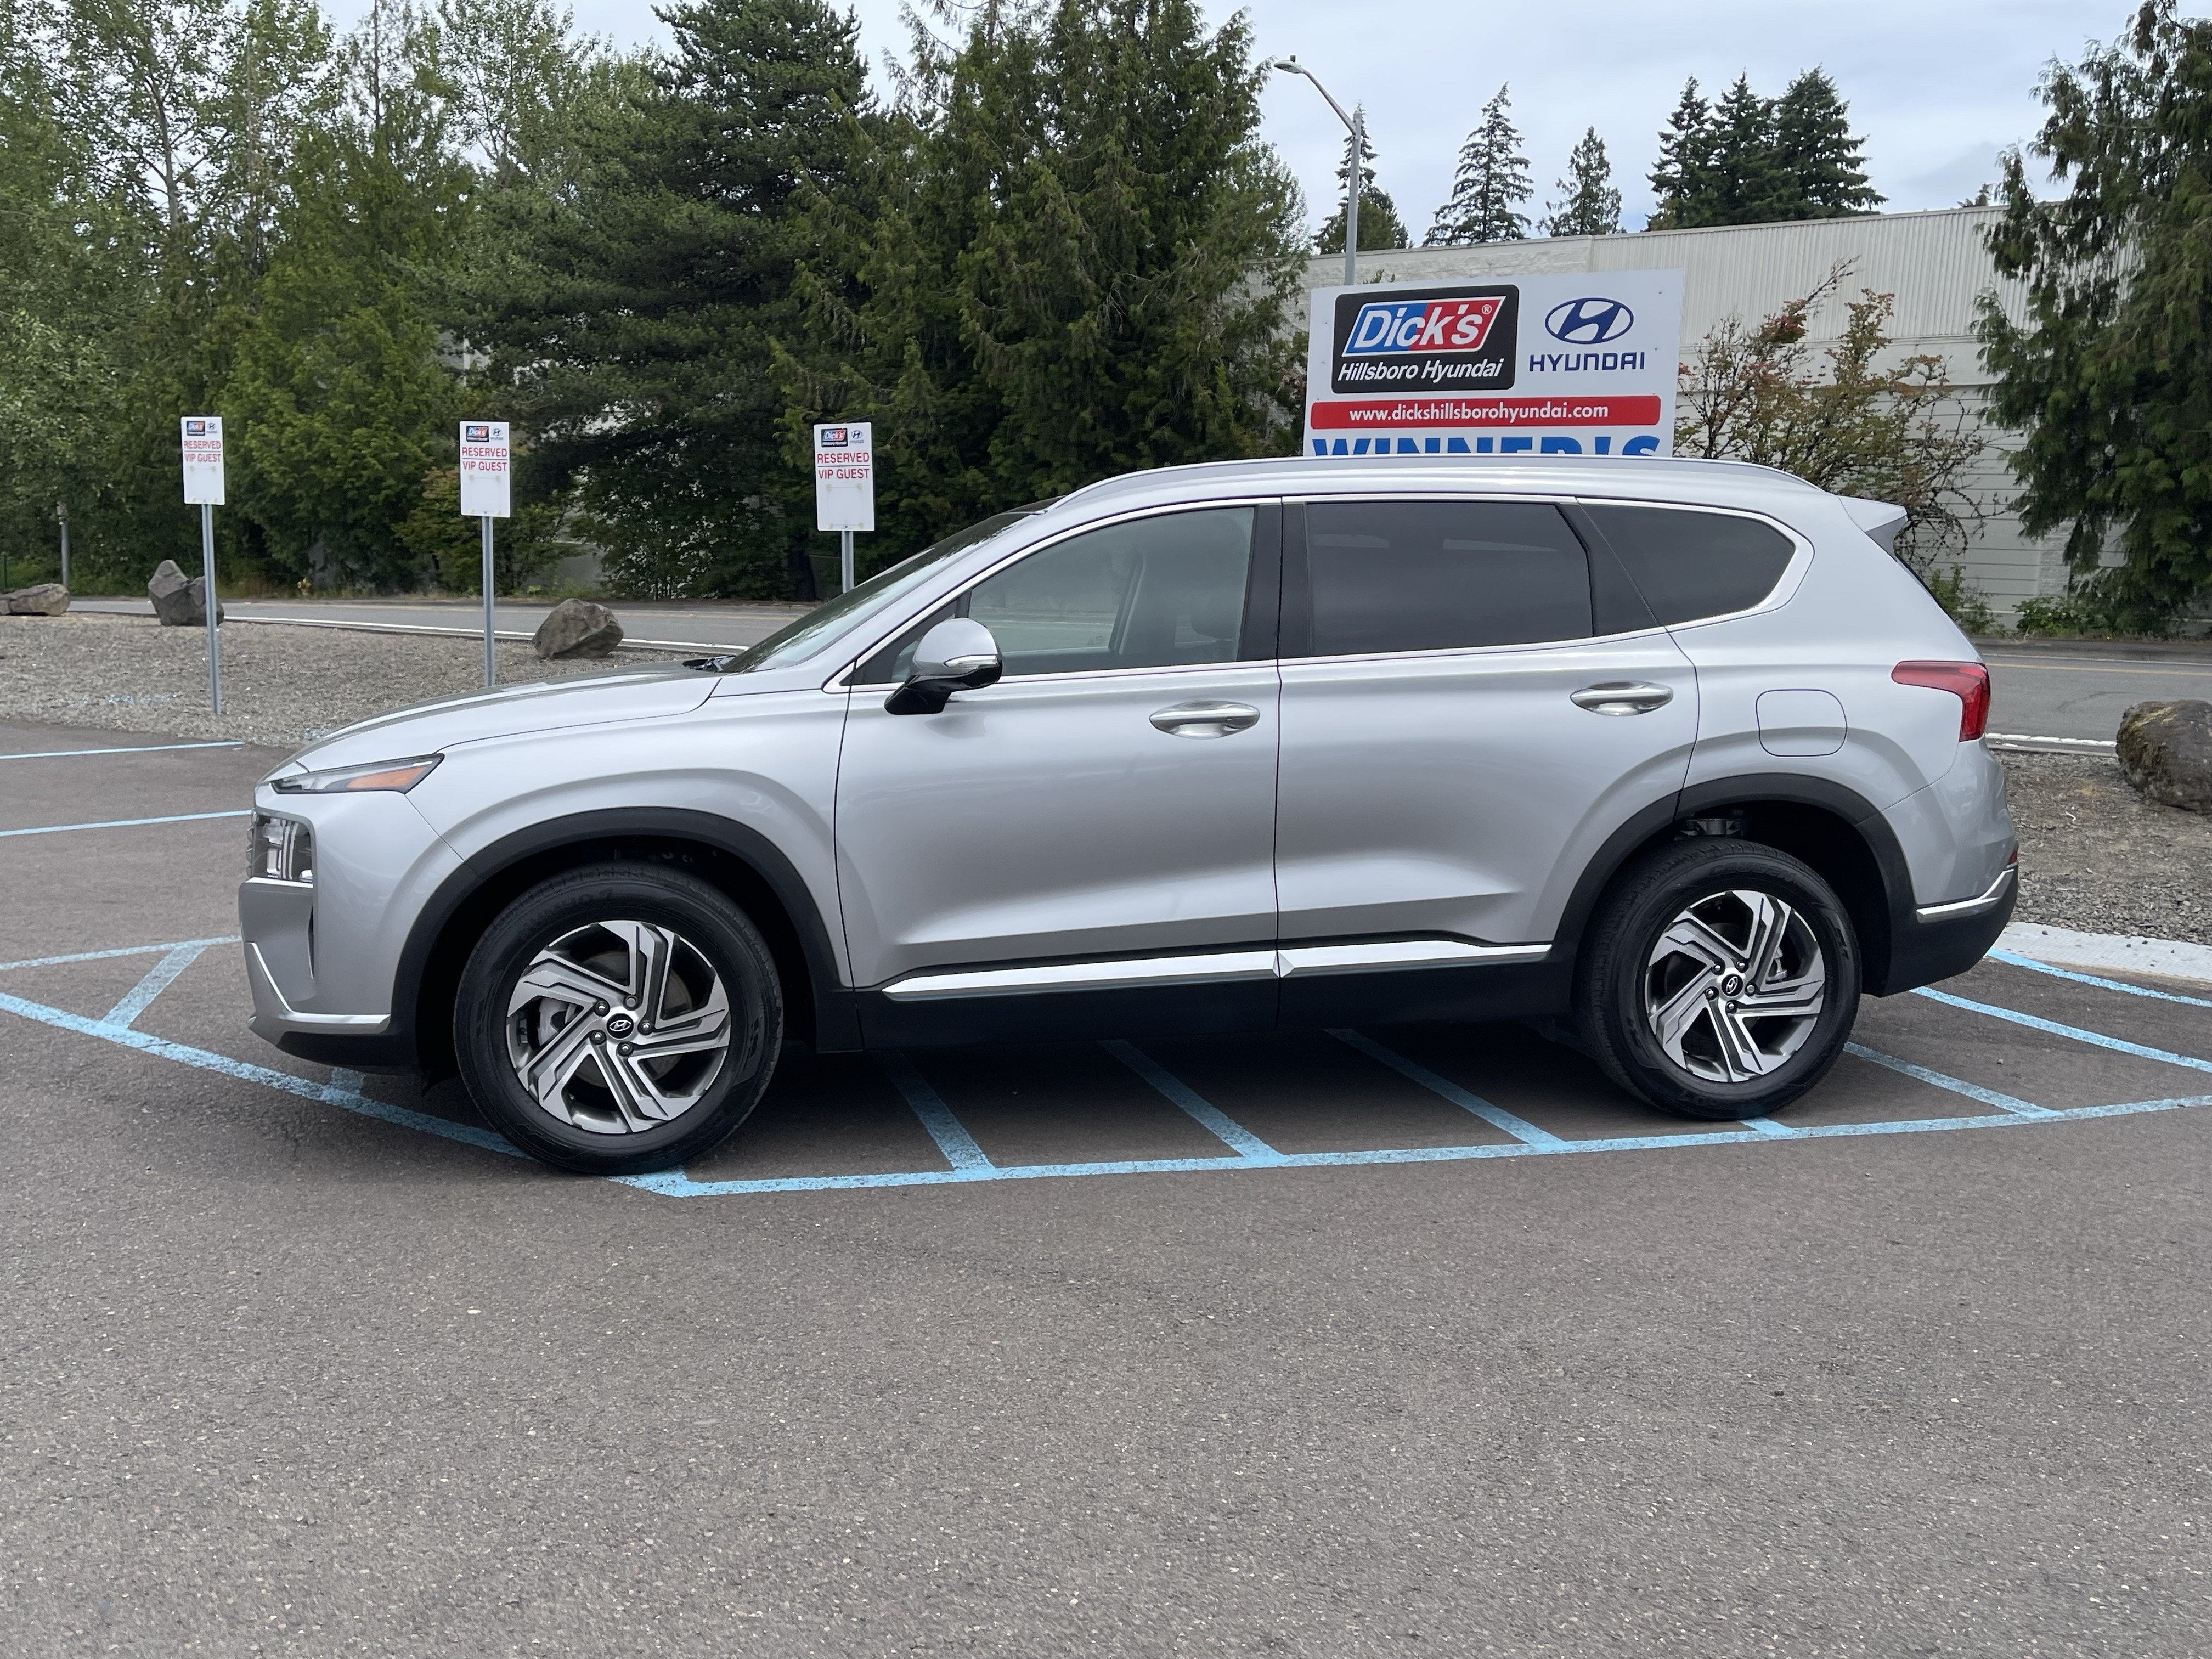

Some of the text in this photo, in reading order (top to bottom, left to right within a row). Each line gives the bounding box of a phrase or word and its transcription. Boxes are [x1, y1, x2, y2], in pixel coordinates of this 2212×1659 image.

[1530, 352, 1645, 372] HYUNDAI
[1338, 358, 1504, 383] Hillsboro Hyundai
[1350, 402, 1609, 424] www.dickshillsborohyundai.com
[184, 441, 221, 449] RESERVED
[462, 447, 507, 457] RESERVED
[184, 454, 221, 462] VIP GUEST
[817, 452, 870, 464] RESERVED
[462, 461, 507, 471] VIP GUEST
[818, 469, 870, 479] VIP GUEST
